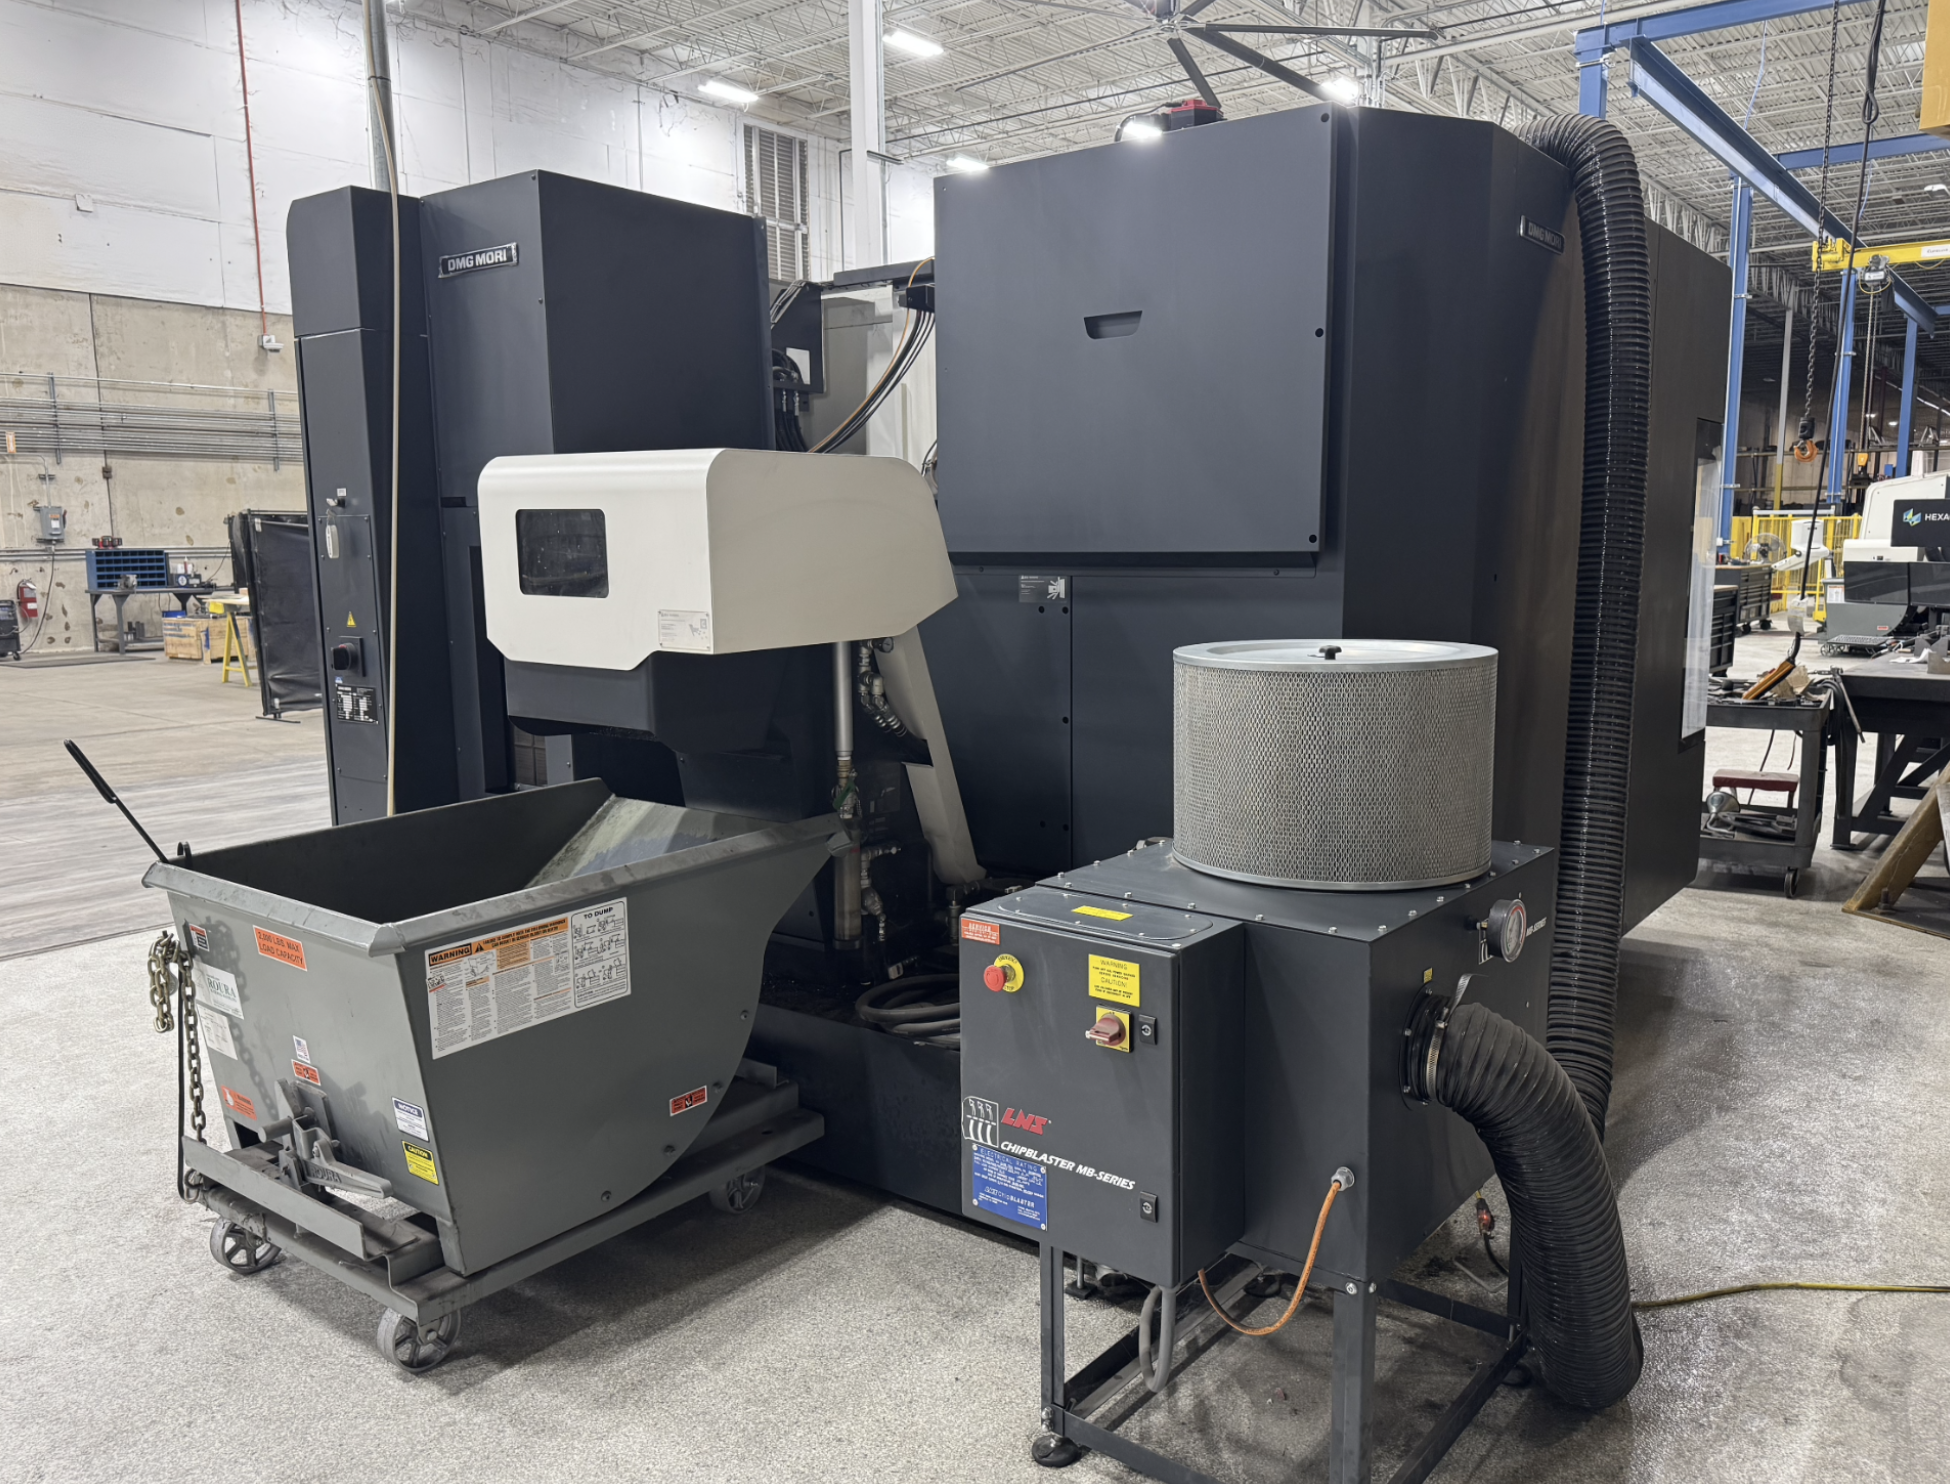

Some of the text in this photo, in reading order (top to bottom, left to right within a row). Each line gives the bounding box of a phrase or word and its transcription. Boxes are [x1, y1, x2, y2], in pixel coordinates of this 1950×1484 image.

[1528, 222, 1562, 250] DMG MORI
[447, 248, 507, 272] DMG MORI
[1925, 513, 1950, 521] HEXA
[594, 906, 613, 917] DUMP
[258, 931, 272, 943] 2,000
[286, 941, 300, 953] MAX
[259, 942, 303, 964] LOAD CAPACITY
[430, 946, 470, 963] WARNING
[207, 977, 237, 998] ROURA
[397, 1103, 419, 1116] NOTICE
[1001, 1107, 1048, 1136] LNS
[407, 1145, 429, 1159] CAUTION
[980, 1148, 1038, 1172] ELECTRICAL RATING
[309, 1166, 342, 1183] ROURA
[1001, 1141, 1075, 1171] CHIPBLASTER
[1076, 1164, 1136, 1190] MB-SERIES
